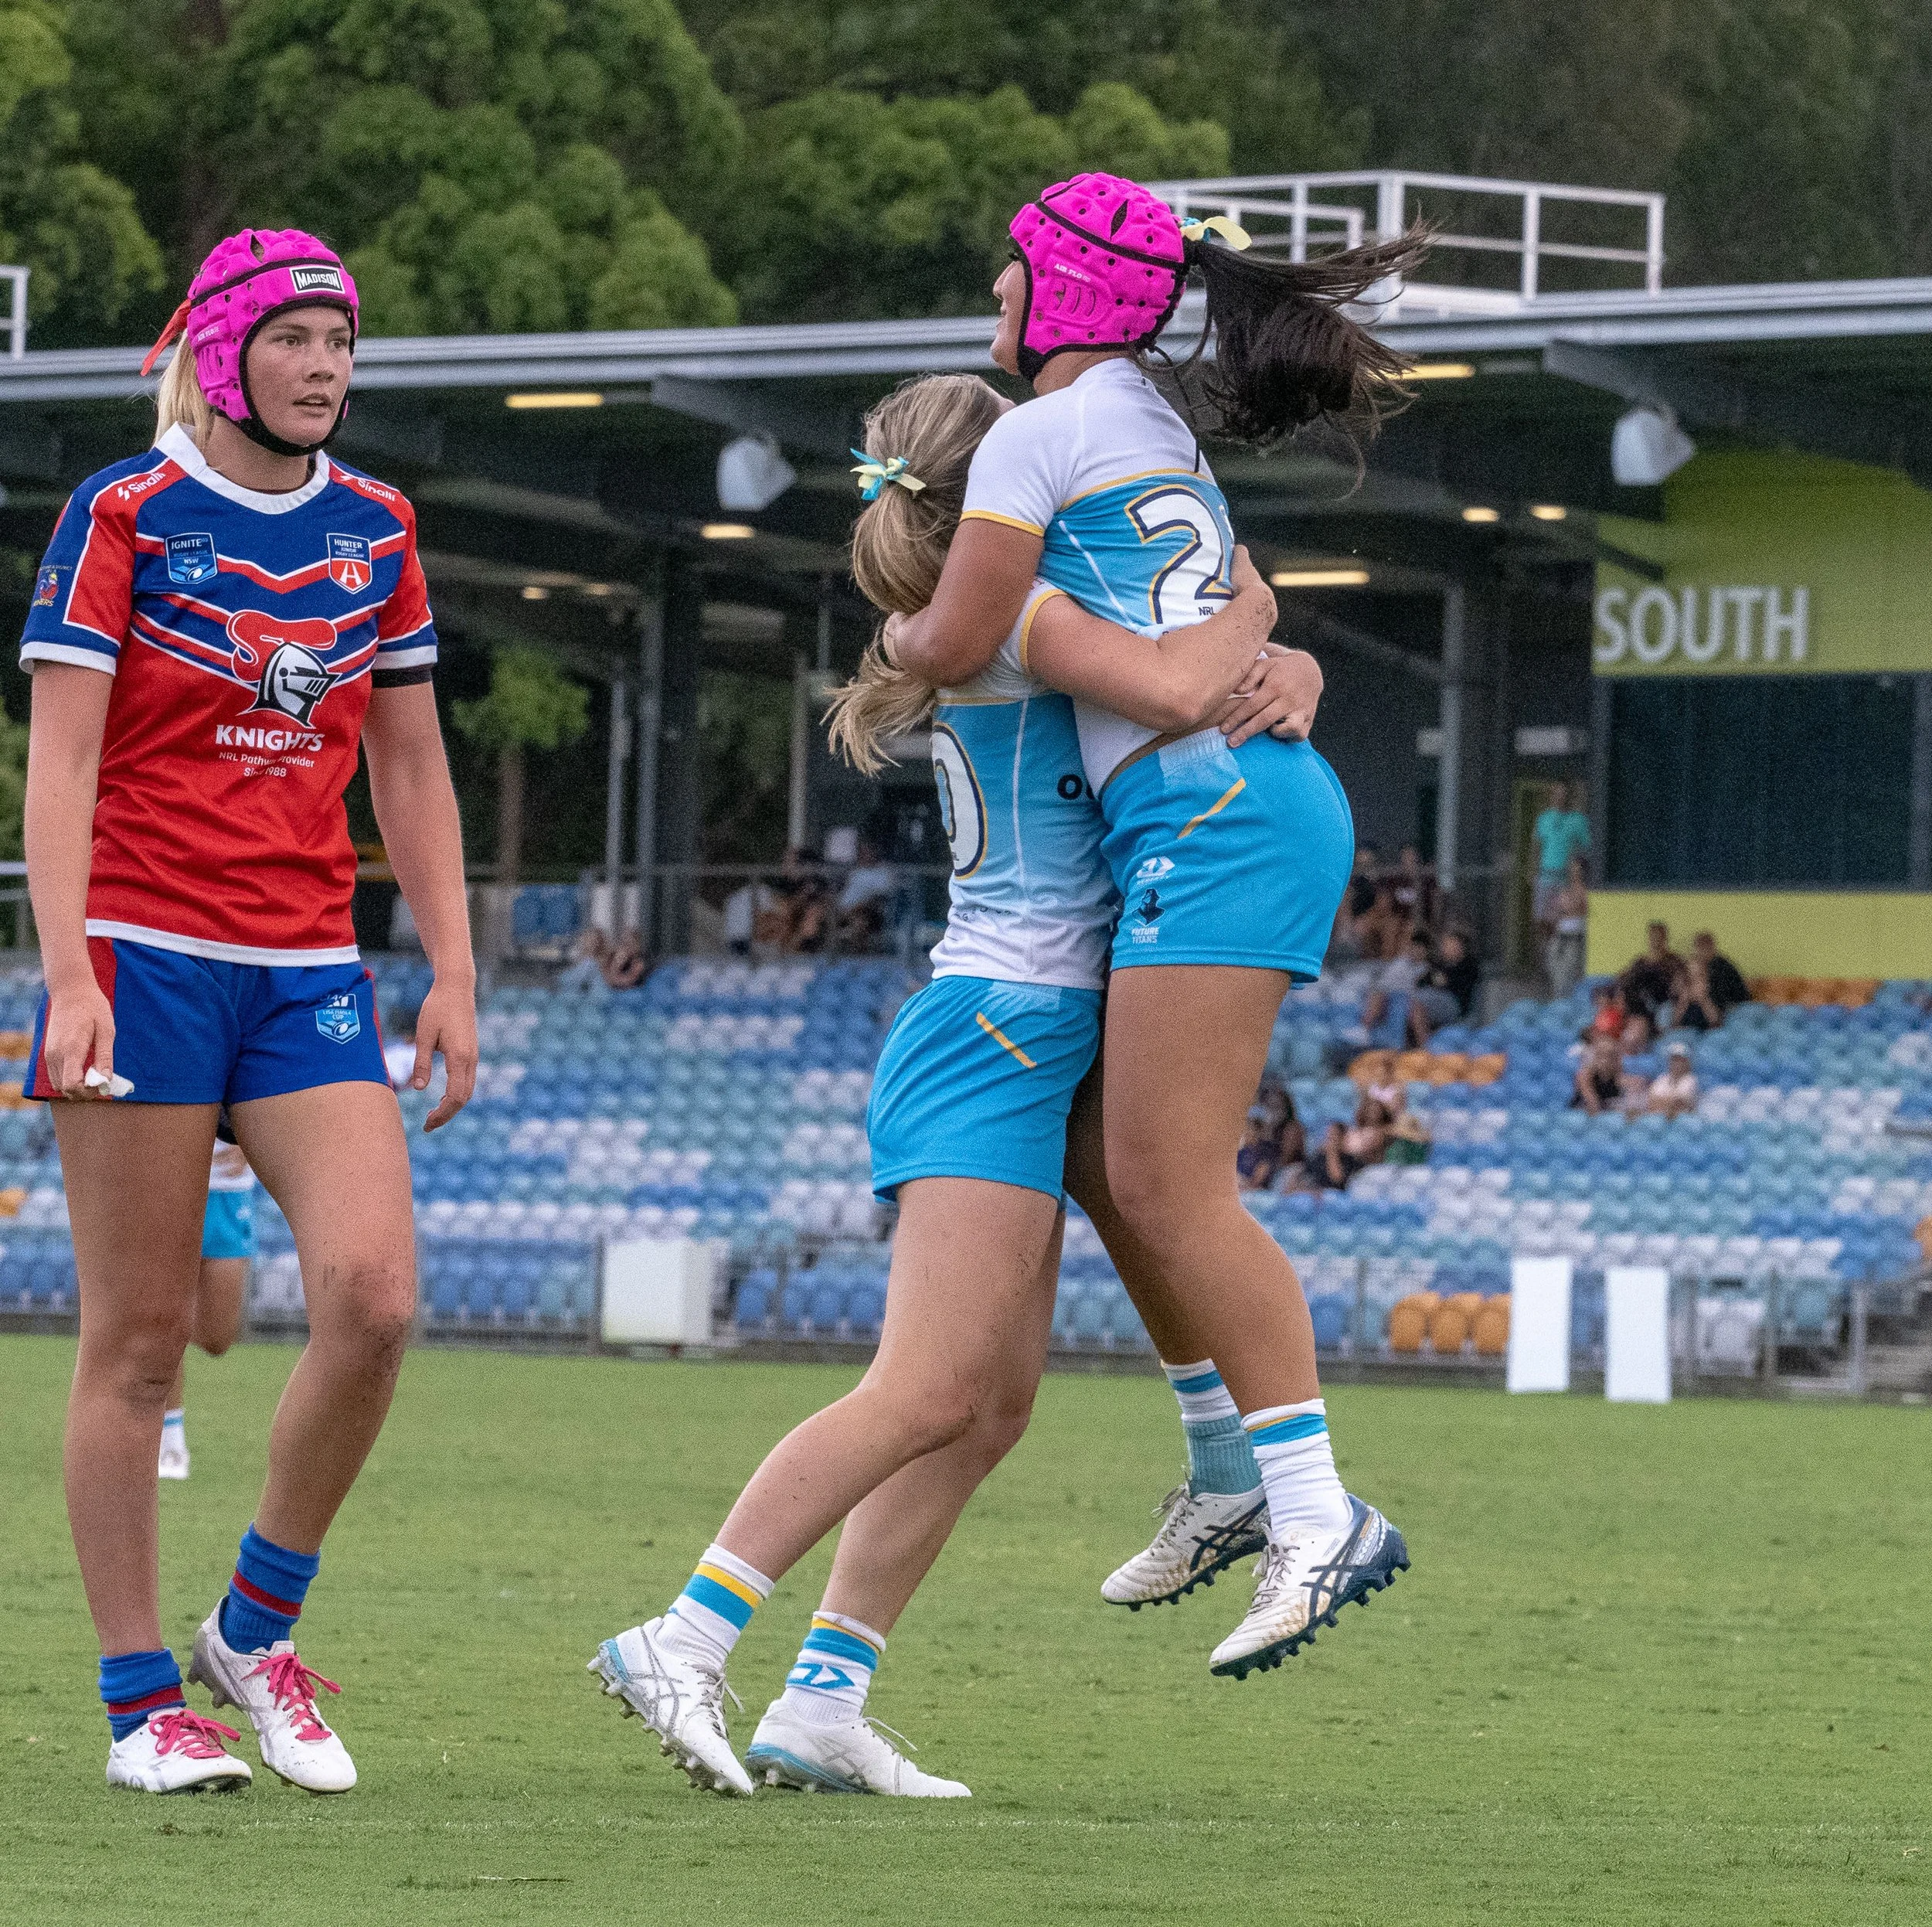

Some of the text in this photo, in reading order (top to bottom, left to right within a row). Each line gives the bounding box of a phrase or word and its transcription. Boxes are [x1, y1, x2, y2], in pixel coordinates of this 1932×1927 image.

[294, 271, 341, 290] MADISON
[172, 539, 202, 550] IGNITE
[334, 539, 362, 549] HUNTER
[1198, 606, 1216, 616] NRL
[1593, 585, 1811, 663] SOUTH
[215, 723, 325, 752] KNIGHTS
[219, 751, 239, 761] NRL
[240, 754, 277, 766] Pathw
